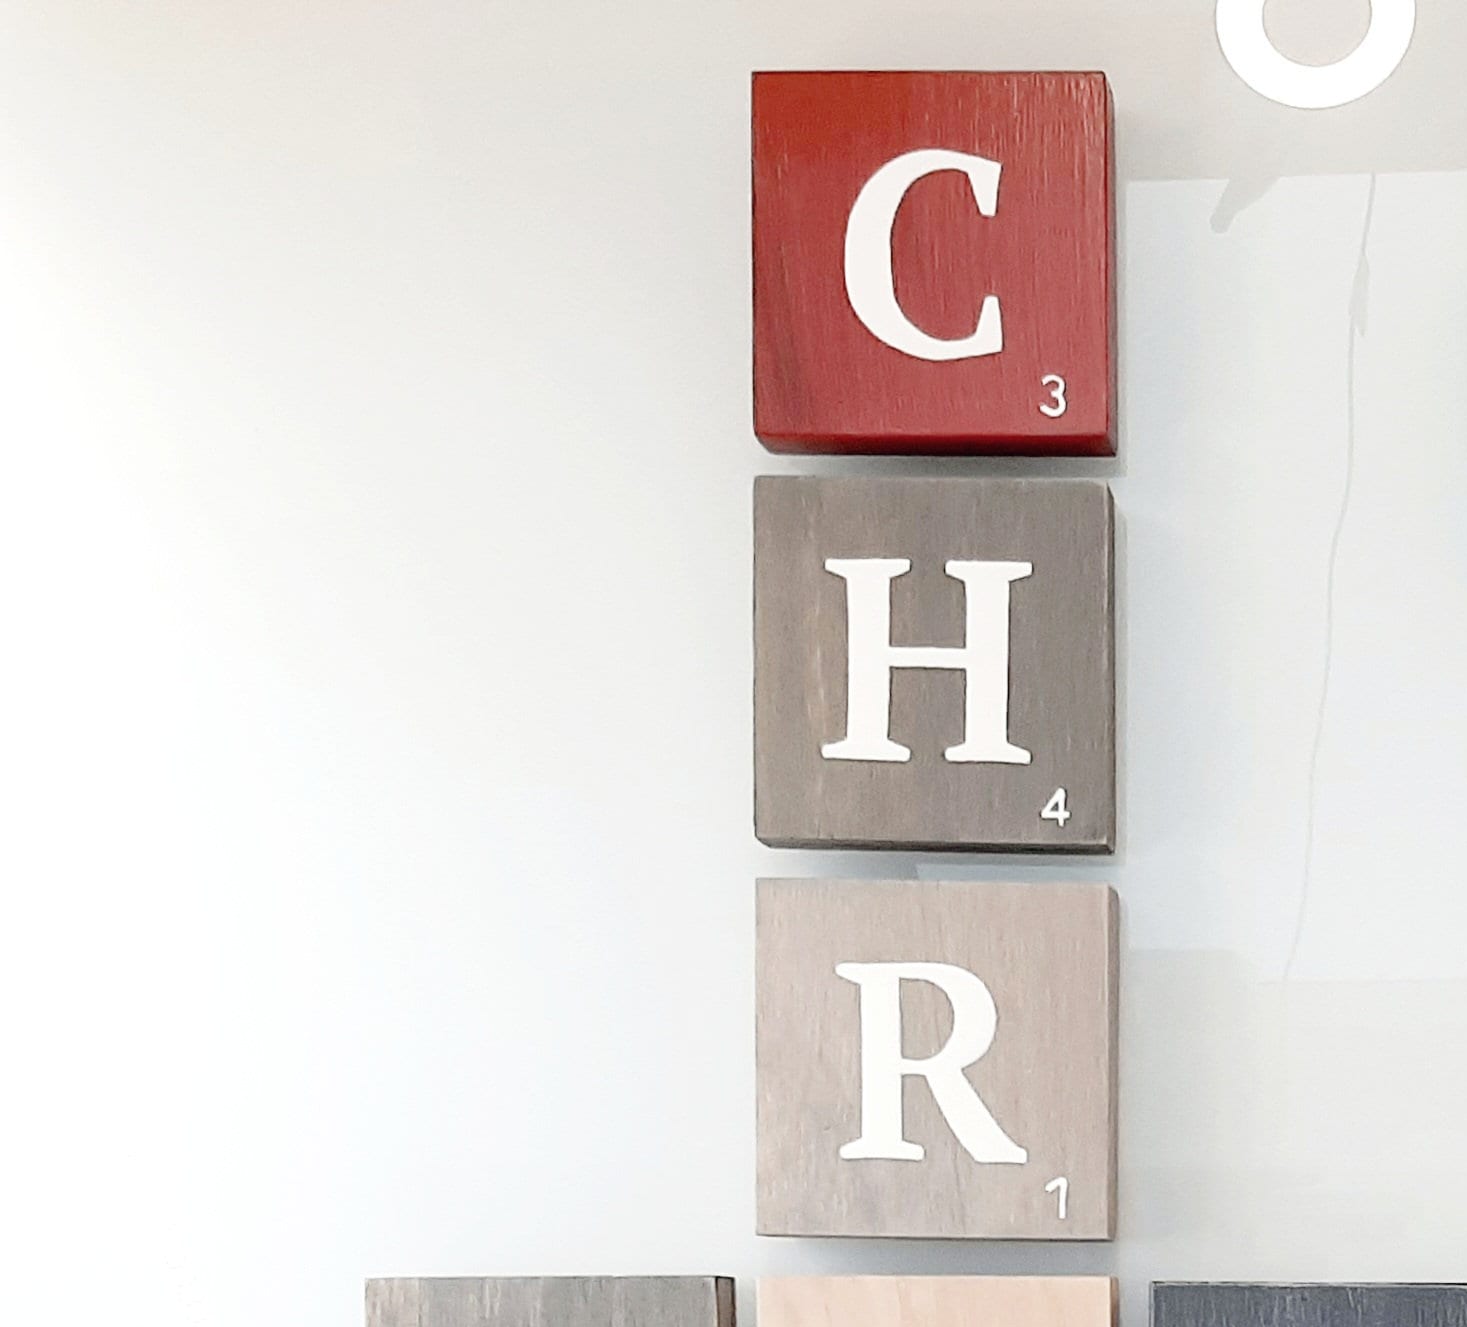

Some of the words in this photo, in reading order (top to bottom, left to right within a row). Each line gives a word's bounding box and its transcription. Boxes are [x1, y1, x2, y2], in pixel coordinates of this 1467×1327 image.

[1039, 375, 1067, 417] 3
[1041, 788, 1070, 827] 4
[1045, 1176, 1068, 1220] 1
